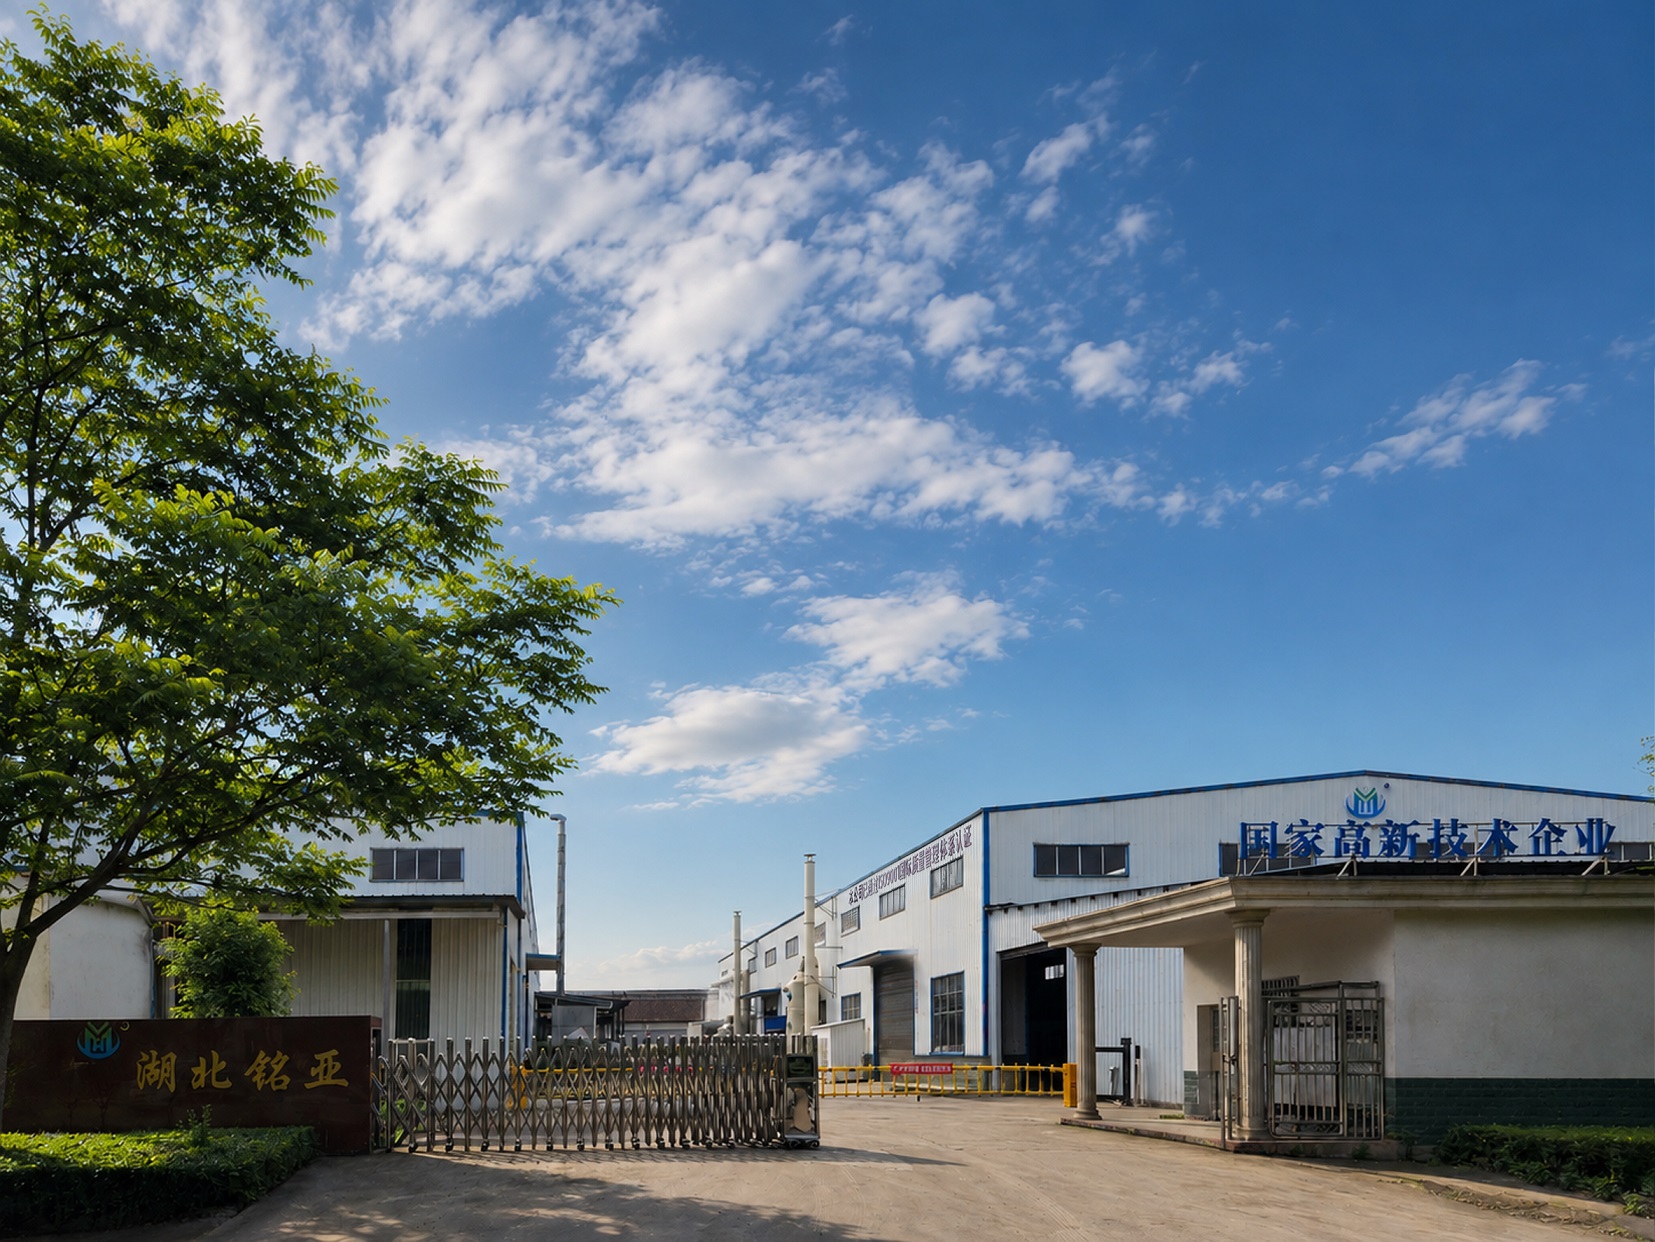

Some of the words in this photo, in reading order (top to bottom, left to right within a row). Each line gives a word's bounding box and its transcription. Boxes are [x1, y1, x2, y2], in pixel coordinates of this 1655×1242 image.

[1239, 818, 1617, 859] 国家高新技术企业
[136, 1049, 349, 1093] 湖北铭亚
